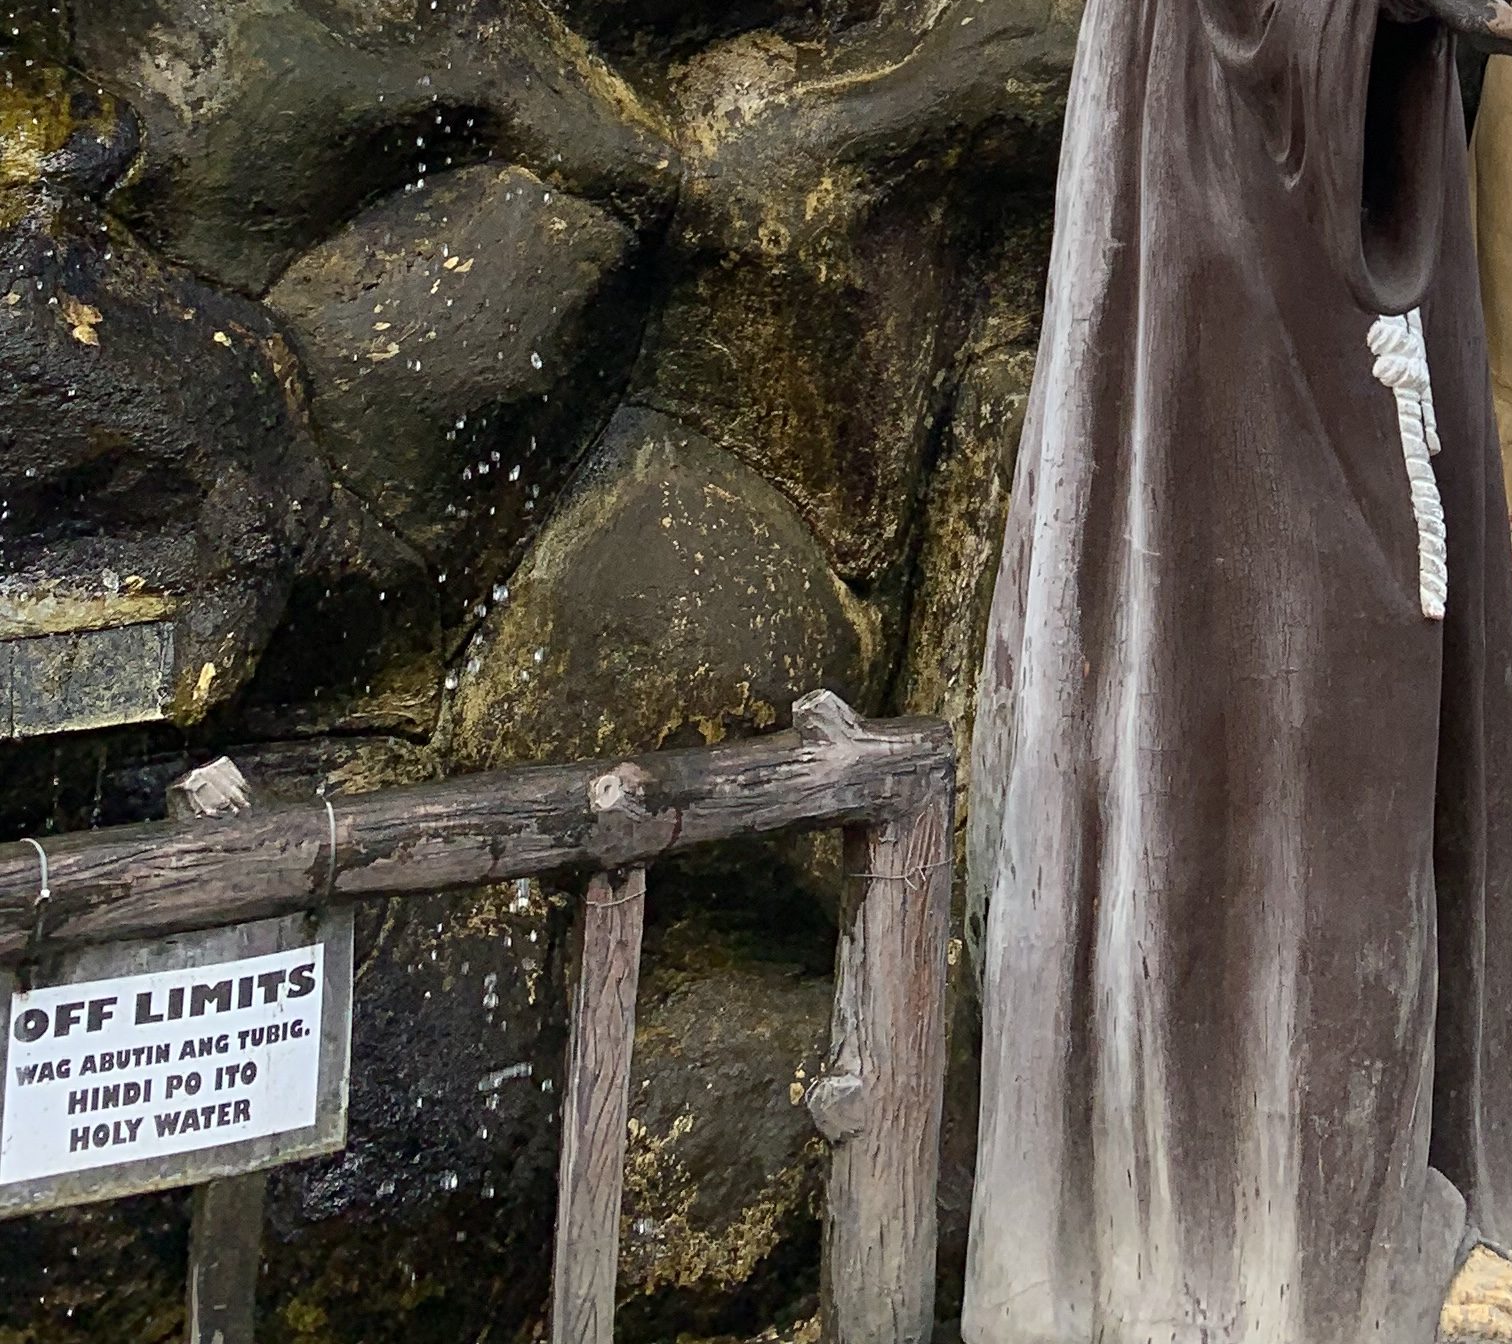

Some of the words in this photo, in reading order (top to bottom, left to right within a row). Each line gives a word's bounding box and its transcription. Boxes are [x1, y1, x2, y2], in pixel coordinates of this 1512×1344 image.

[14, 996, 118, 1043] OFF
[134, 962, 316, 1026] LIMITS
[15, 1058, 71, 1087] WAG
[78, 1043, 171, 1077] ABUTIN
[178, 1033, 229, 1062] ANG
[237, 1018, 311, 1051] TUBIG.
[67, 1078, 152, 1115] HINDI
[164, 1071, 202, 1100] PO
[214, 1061, 258, 1092] ITO
[69, 1116, 145, 1153] HOLY
[153, 1098, 252, 1139] WATER
